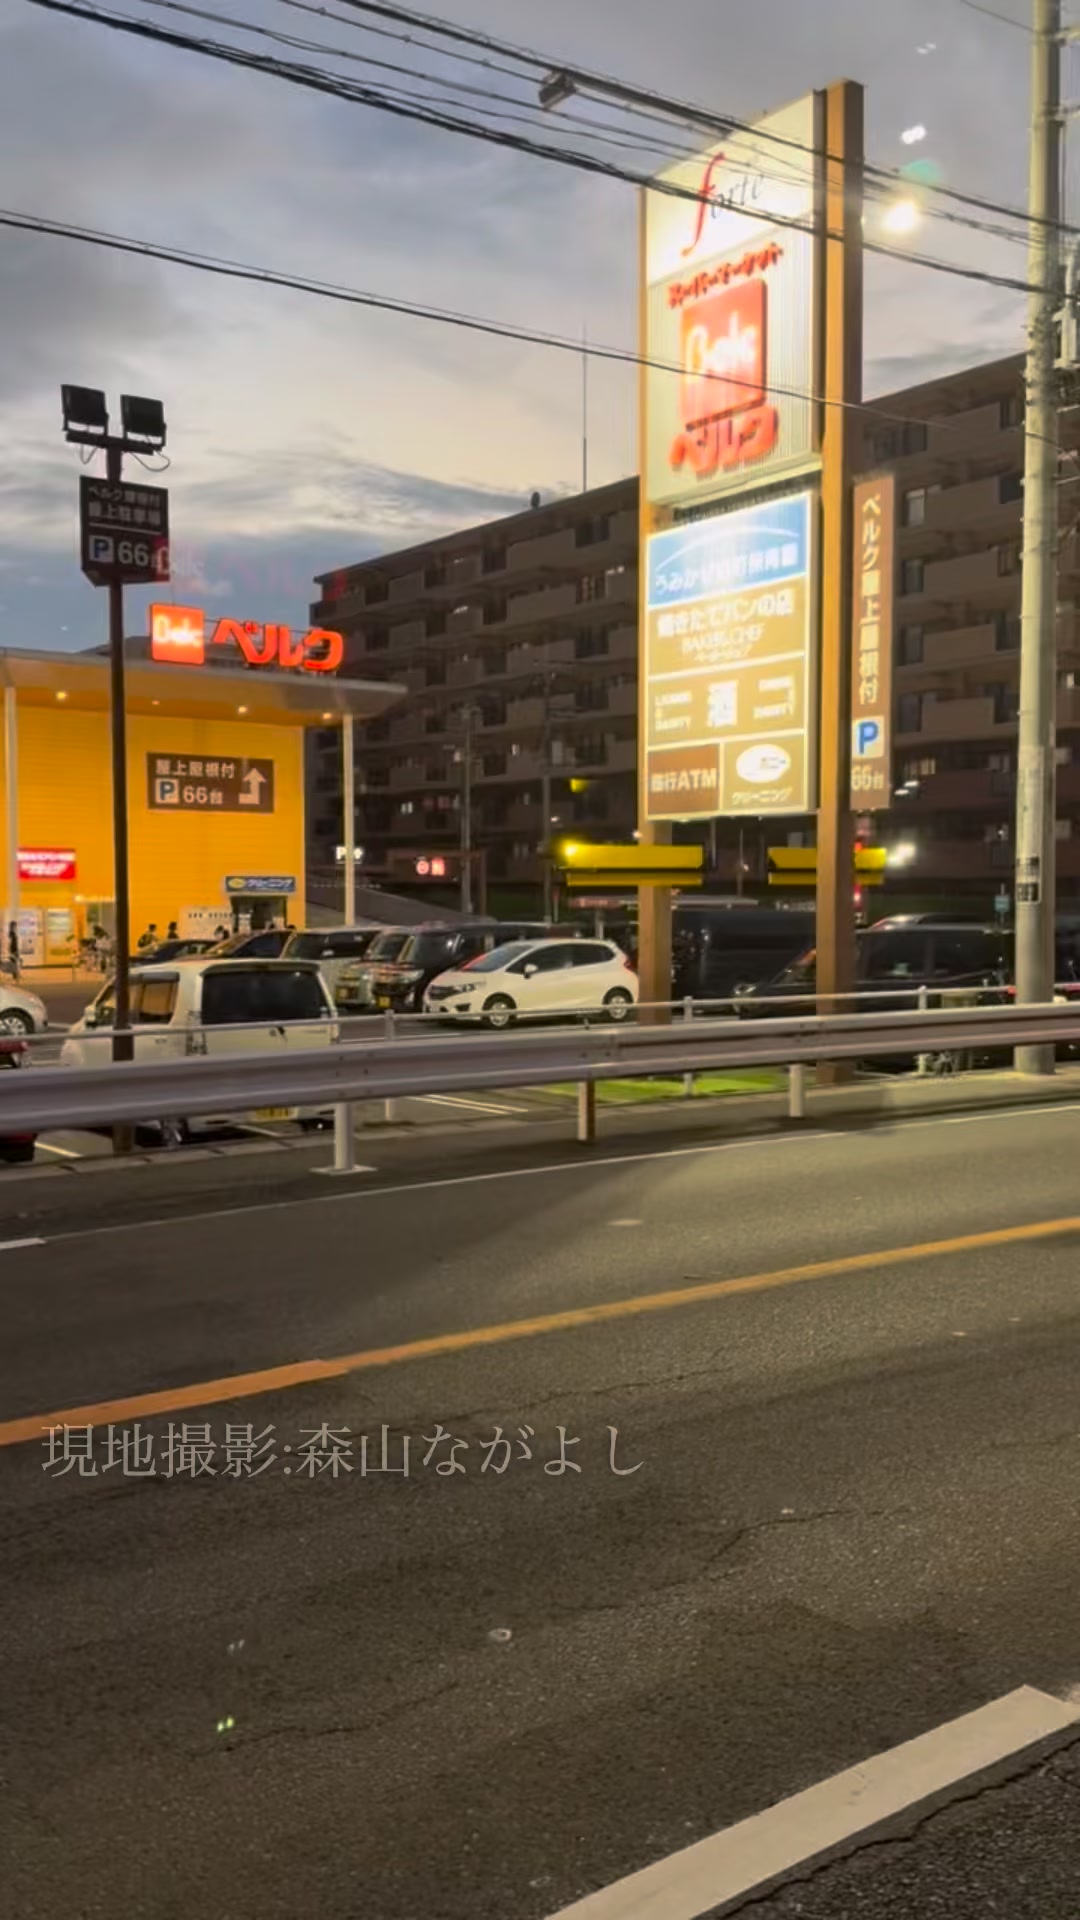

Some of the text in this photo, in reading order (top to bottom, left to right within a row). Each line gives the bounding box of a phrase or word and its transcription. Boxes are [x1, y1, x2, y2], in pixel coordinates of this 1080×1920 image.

[669, 404, 780, 480] ベルク
[211, 617, 345, 672] ベルク
[858, 720, 880, 755] P
[160, 780, 175, 801] P
[182, 784, 223, 805] 66台
[731, 786, 794, 805] クリーニング
